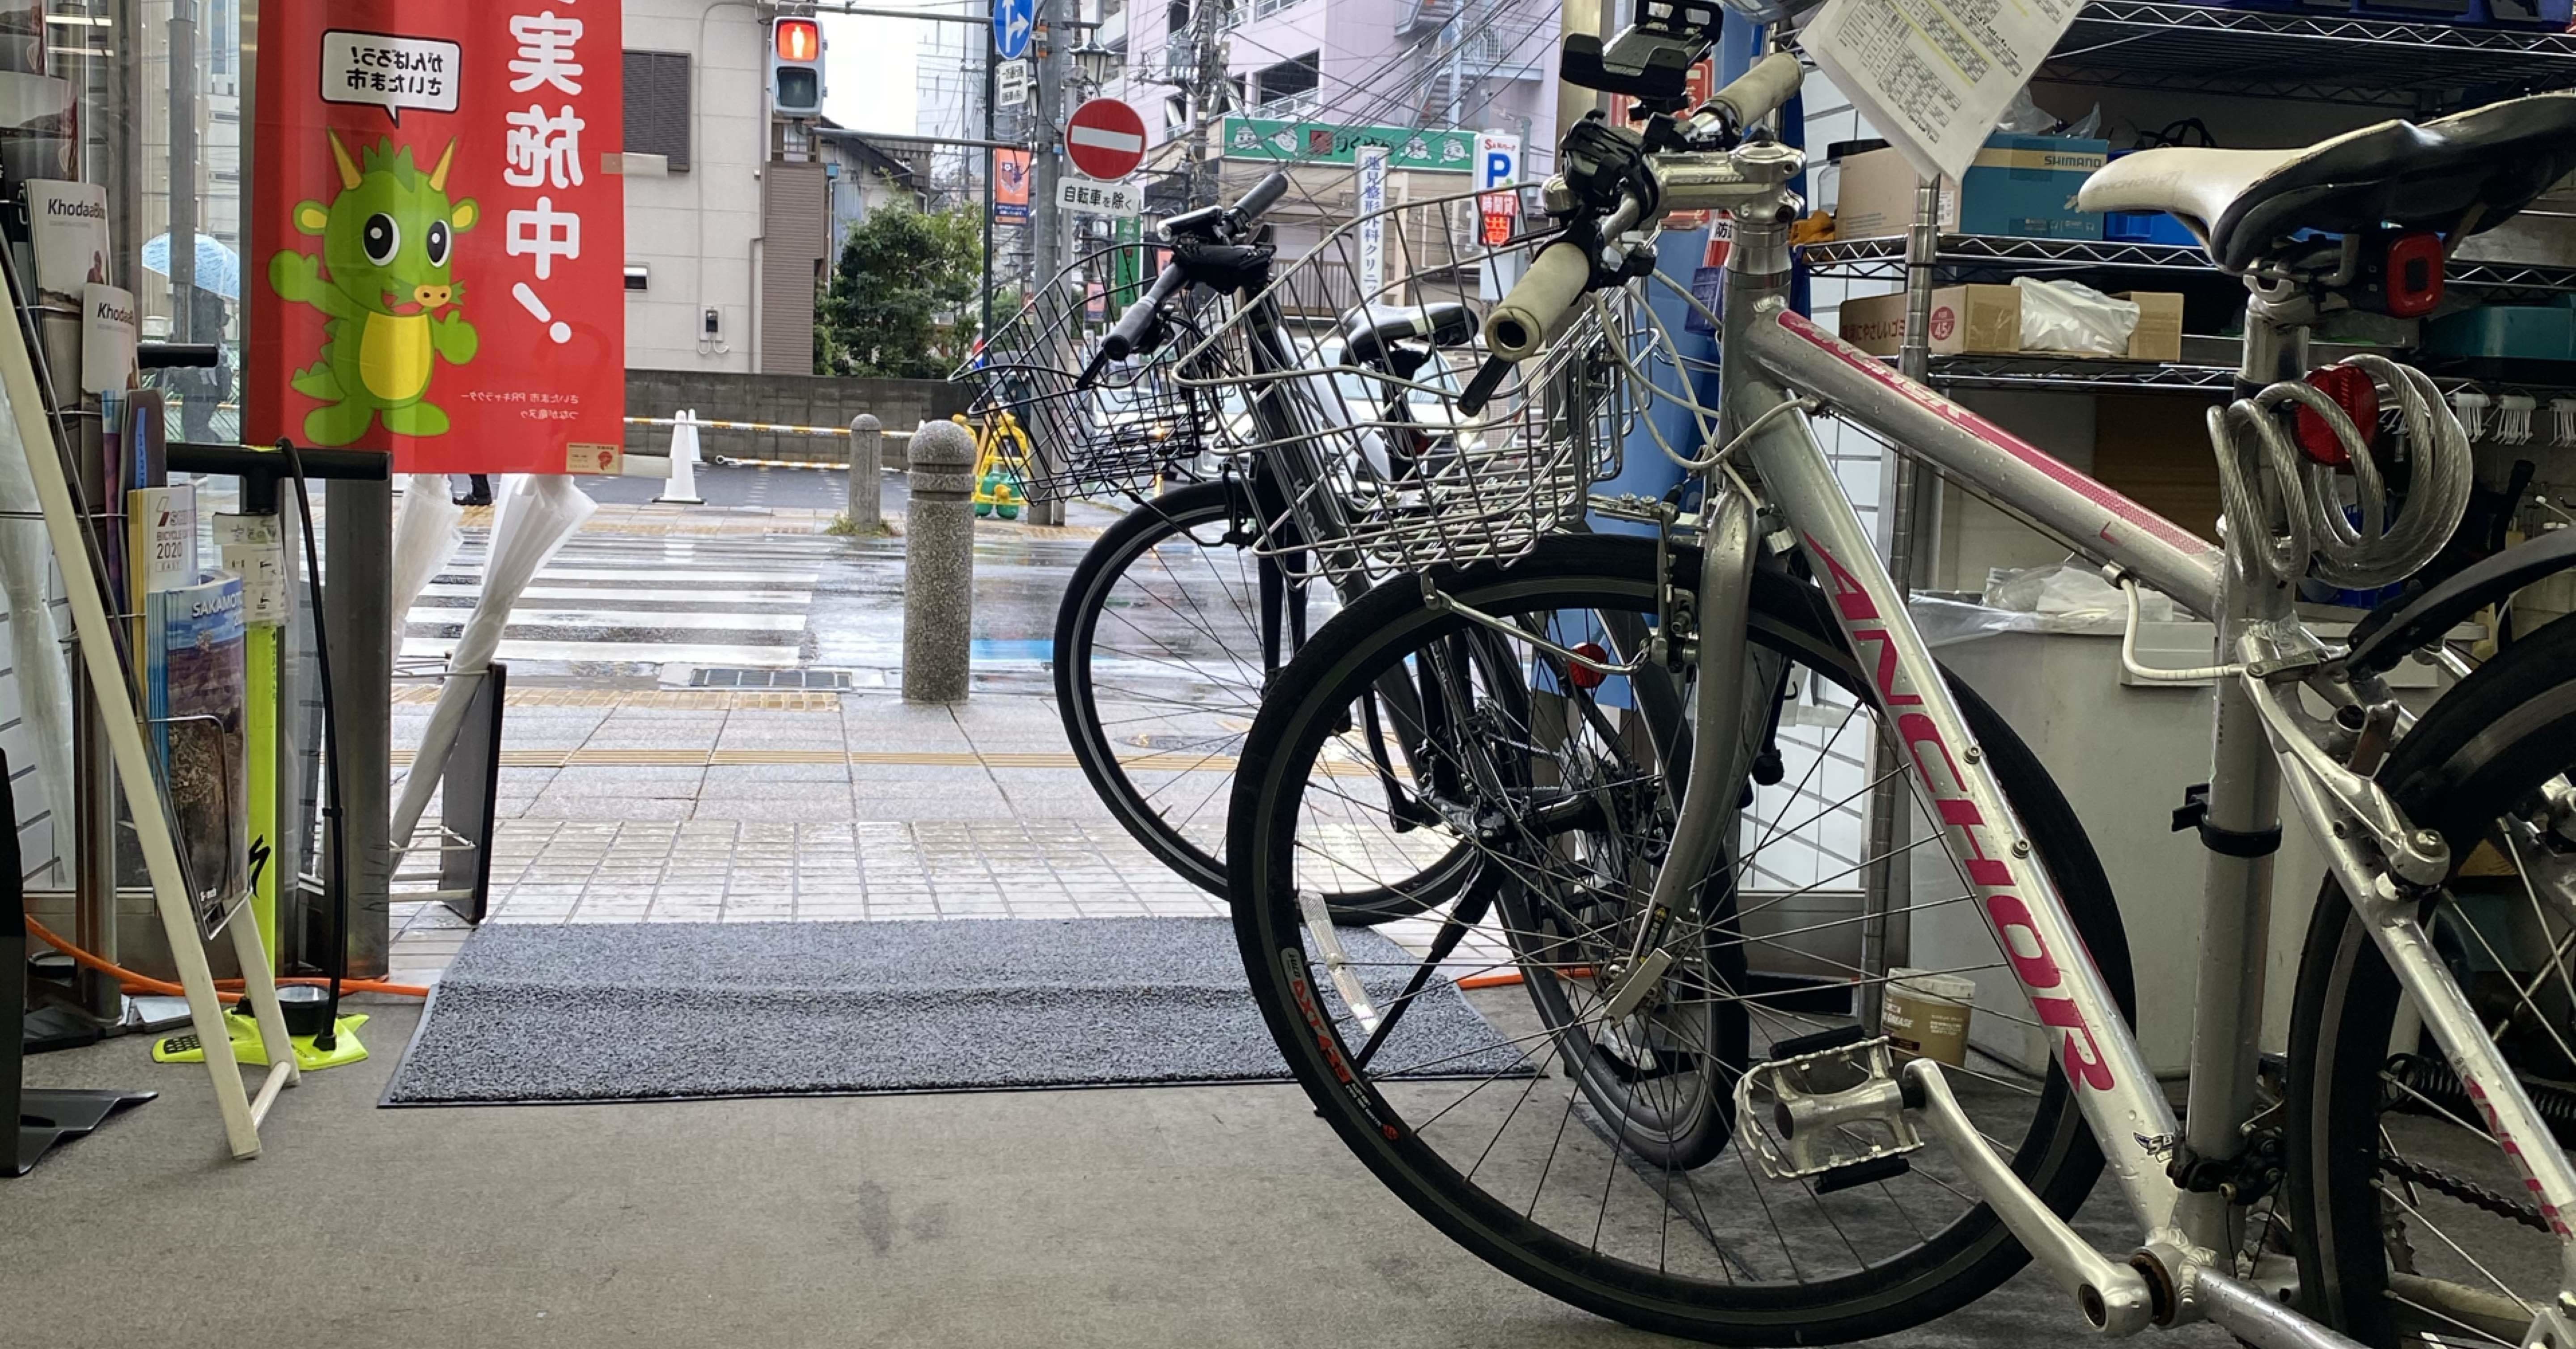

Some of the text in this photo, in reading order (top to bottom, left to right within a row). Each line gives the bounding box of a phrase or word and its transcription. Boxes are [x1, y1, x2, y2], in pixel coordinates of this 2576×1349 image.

[1487, 153, 1511, 187] P
[2044, 156, 2101, 168] SHIMANO
[1064, 185, 1132, 210] 自転車を除く
[157, 541, 182, 559] 2020
[1802, 530, 2114, 1094] ANCHOR
